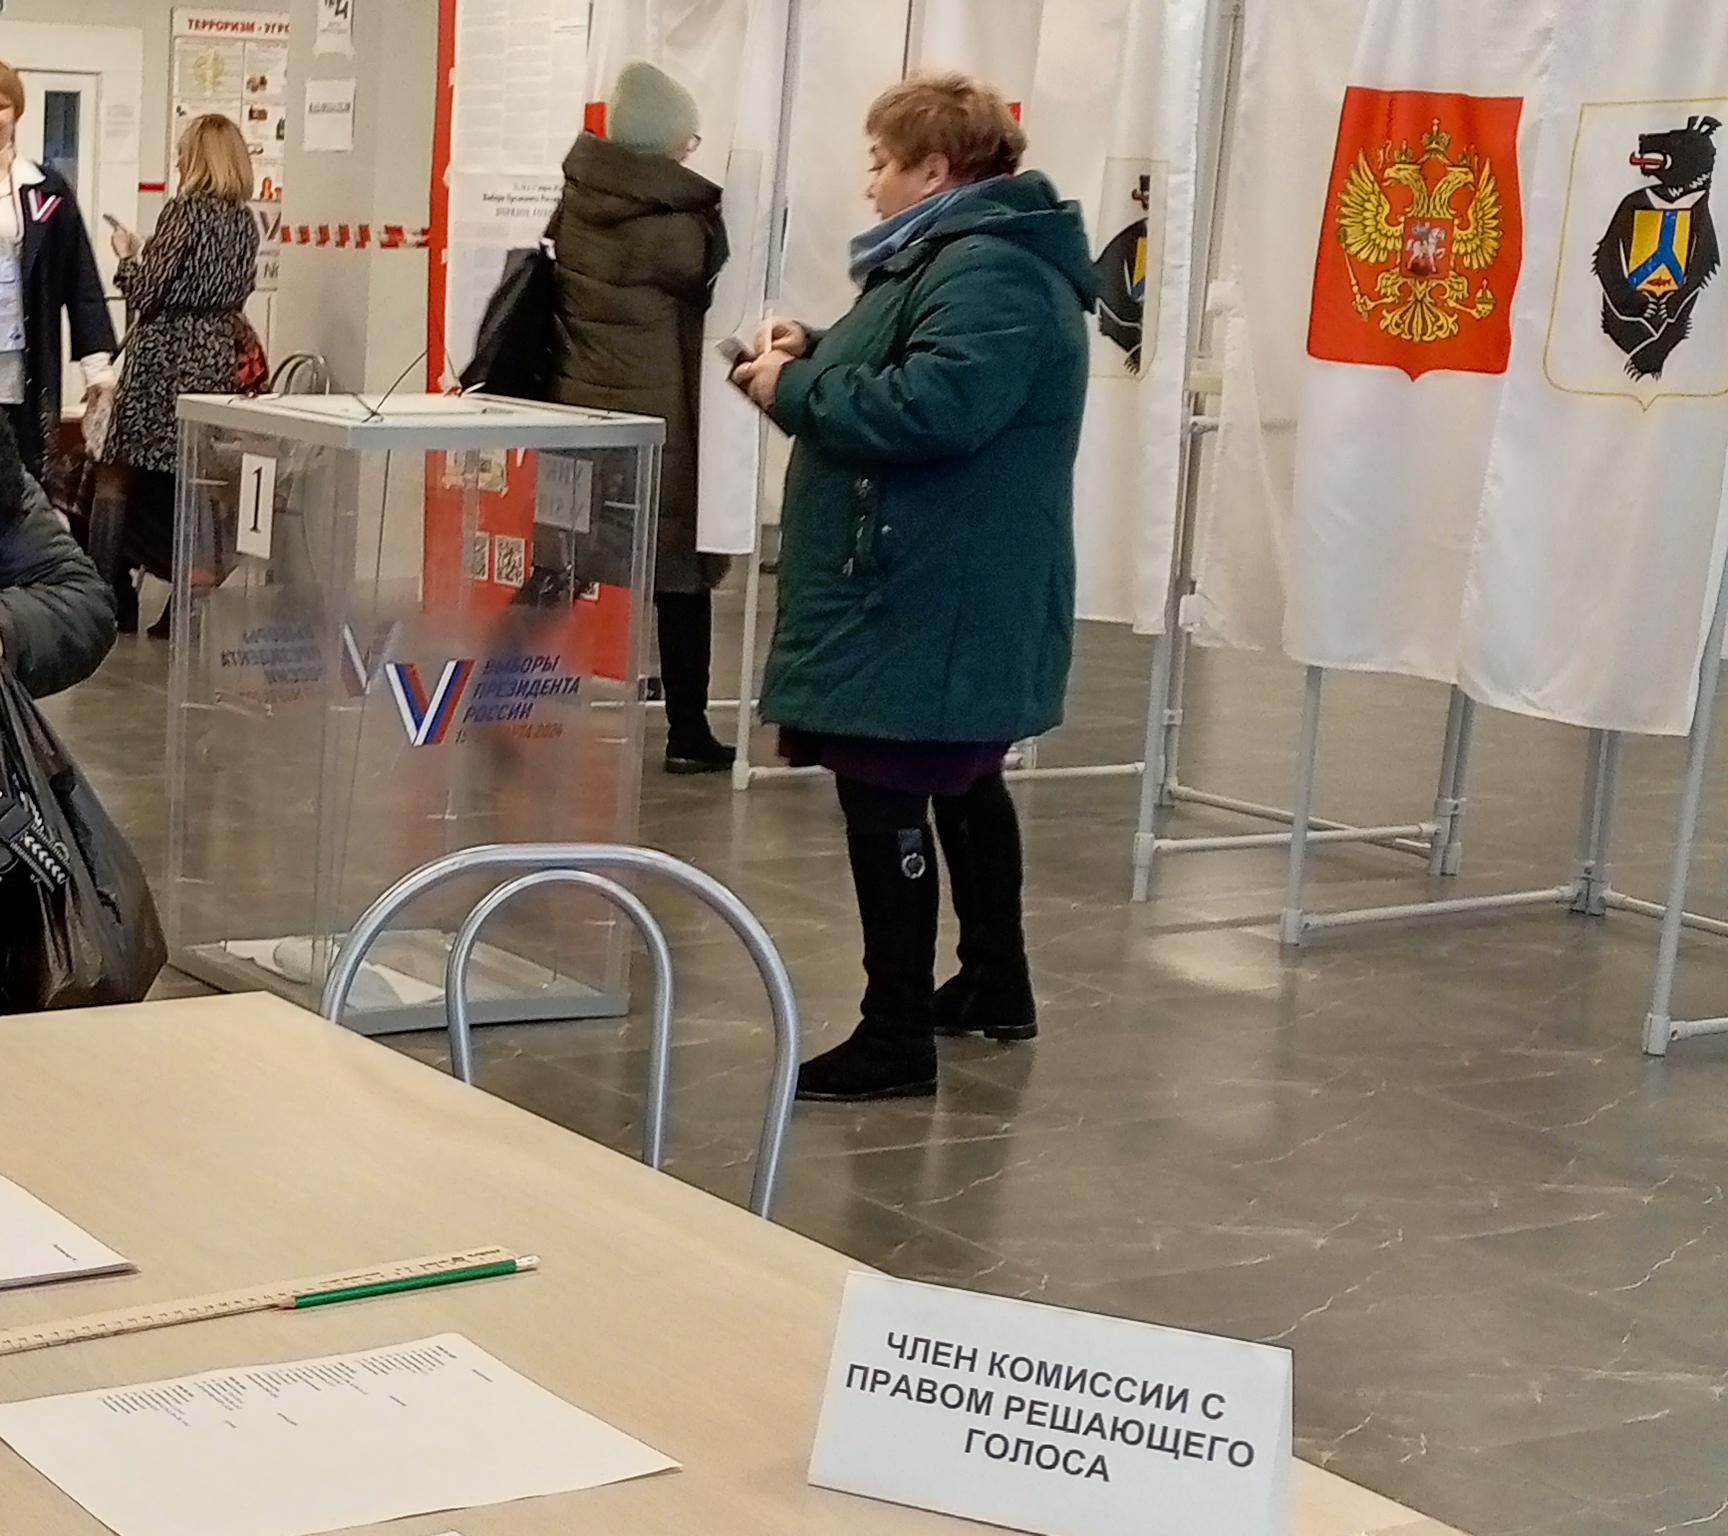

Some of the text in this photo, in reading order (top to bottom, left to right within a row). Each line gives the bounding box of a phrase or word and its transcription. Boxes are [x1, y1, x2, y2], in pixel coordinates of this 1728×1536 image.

[187, 18, 256, 33] ТЕРРОРИЗМ
[249, 465, 263, 535] 1
[482, 654, 560, 675] ВЫБОРЫ
[473, 675, 581, 699] ПРЕЗИДЕНТА
[462, 701, 534, 723] РОССИИ
[886, 1331, 1227, 1420] ЧЛЕН КОМИССИИ С
[845, 1363, 1255, 1468] ПРАВОМ РЕШАЮЩЕГО
[963, 1428, 1111, 1482] ГОЛОСА
